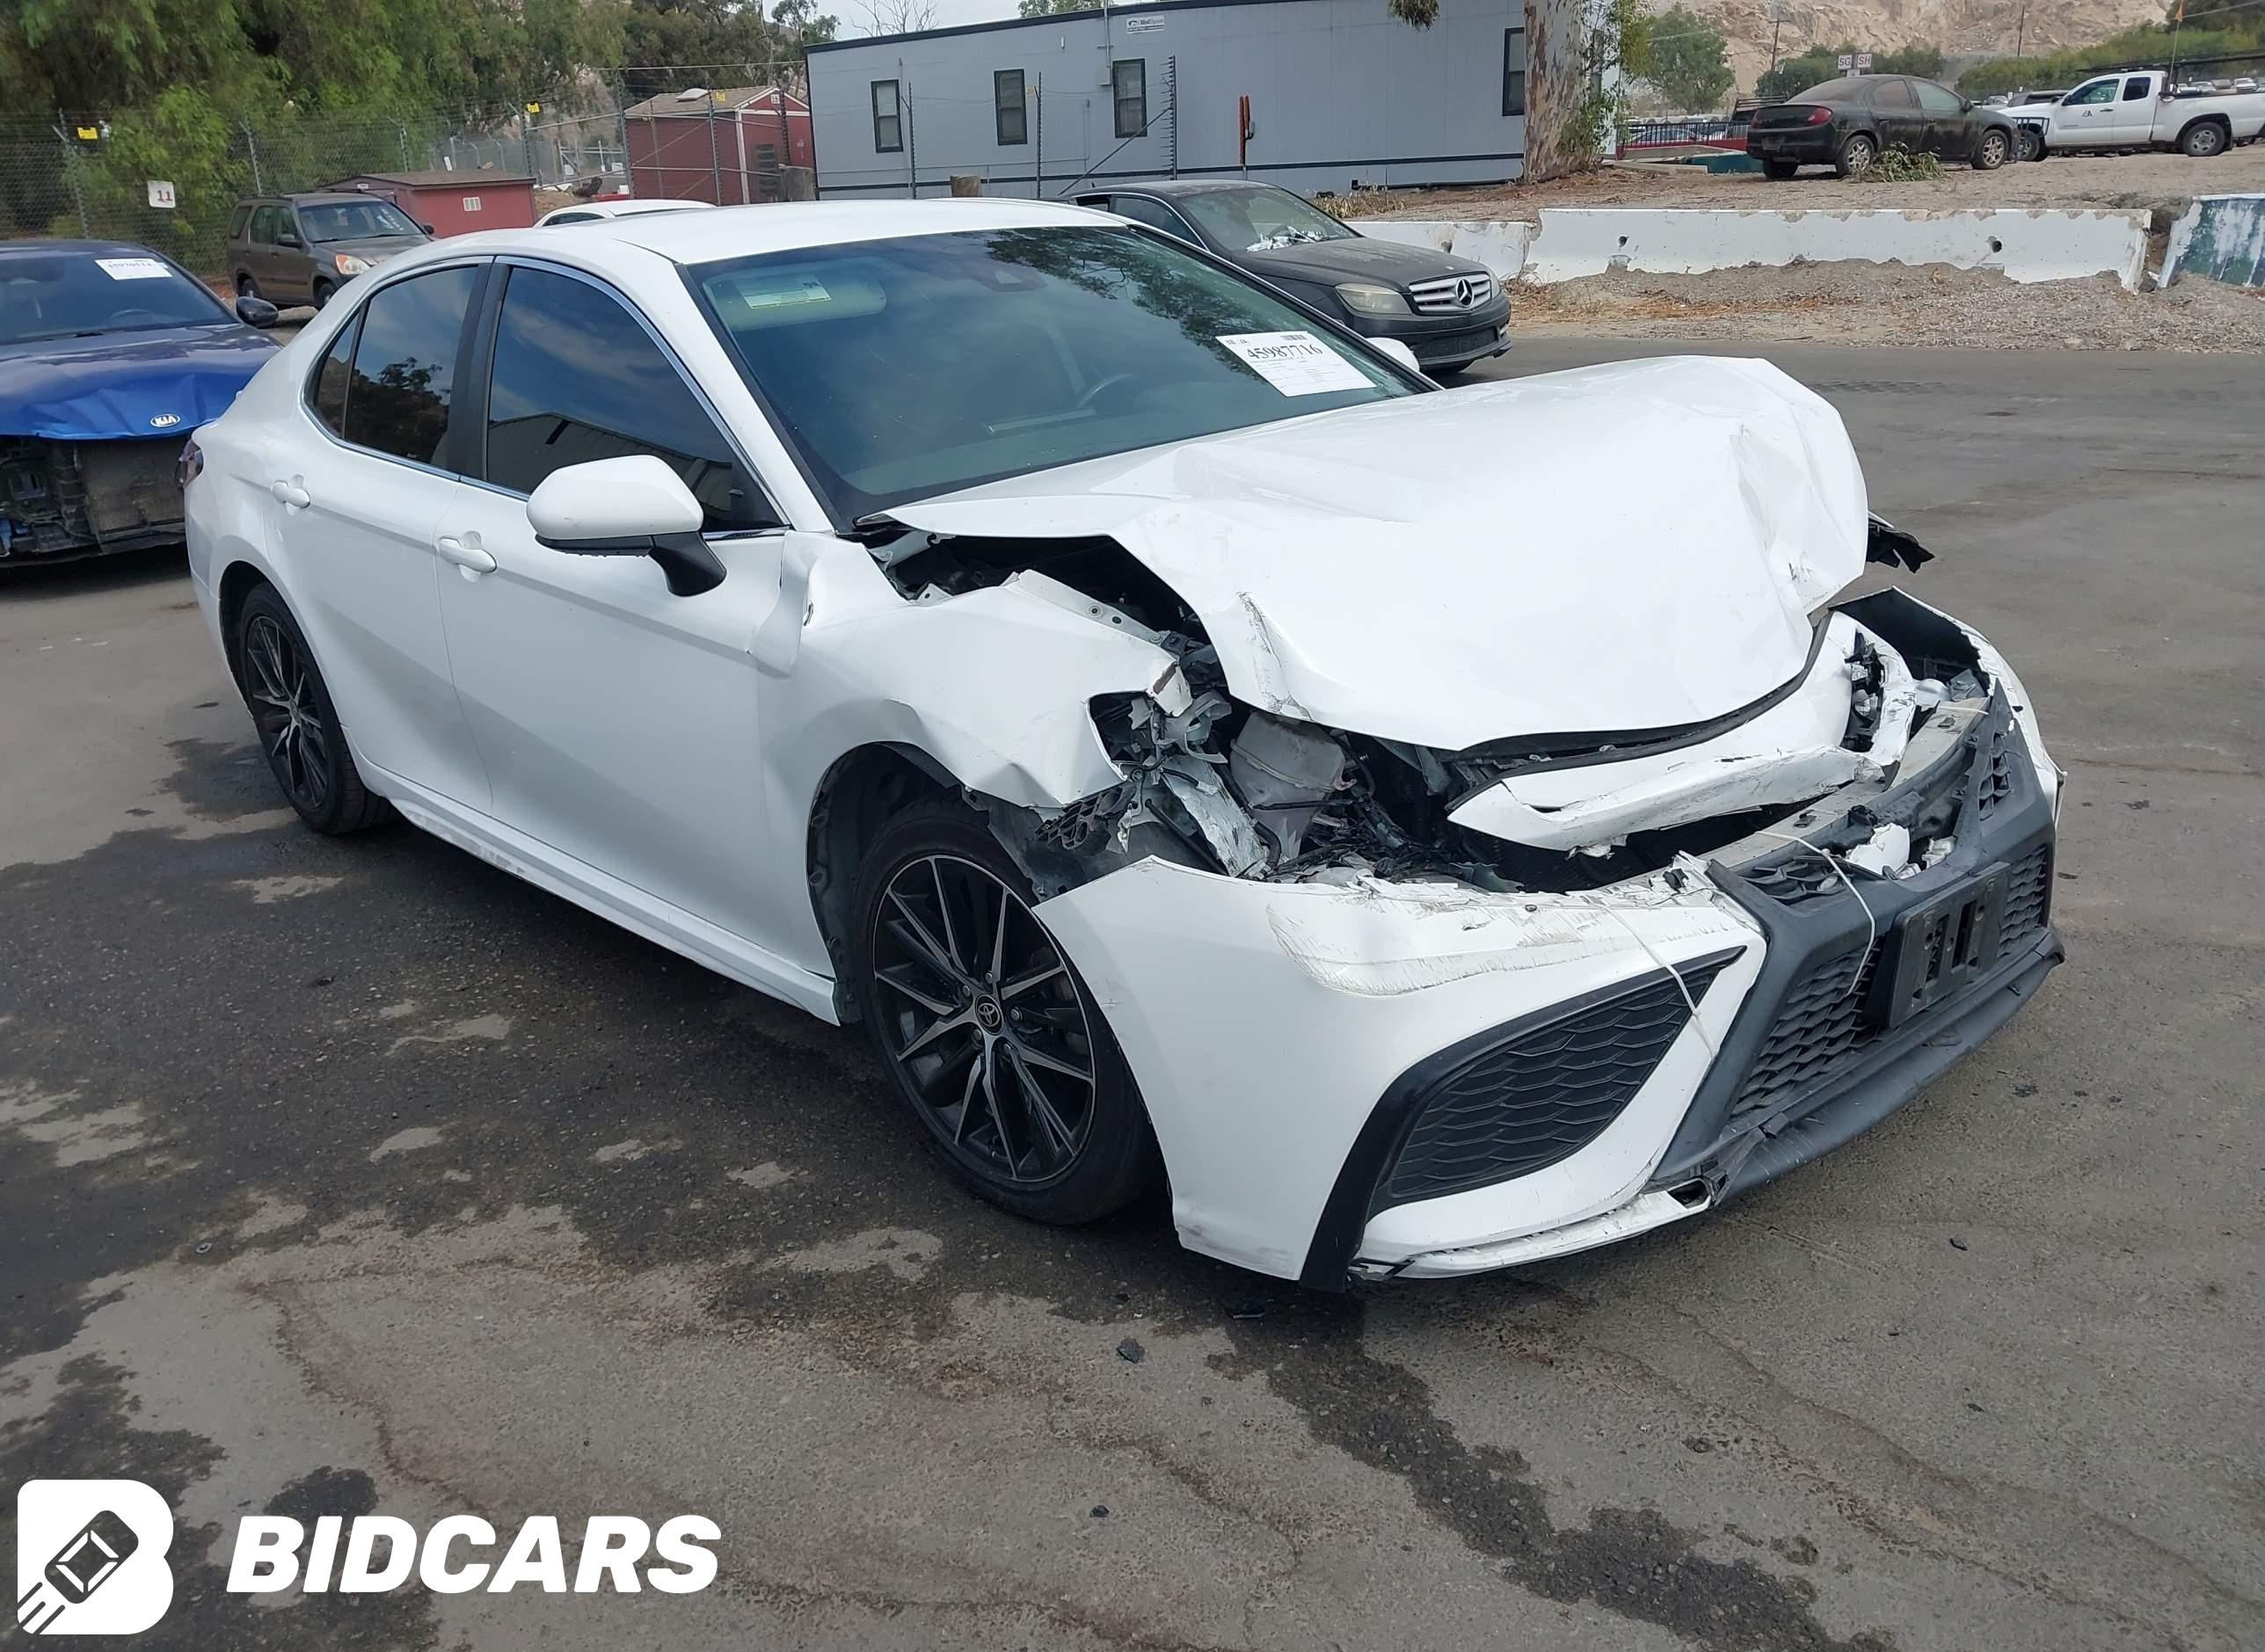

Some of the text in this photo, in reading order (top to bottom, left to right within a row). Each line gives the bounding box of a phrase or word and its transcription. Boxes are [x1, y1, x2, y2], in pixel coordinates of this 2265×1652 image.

[1839, 57, 1851, 66] SG
[1858, 55, 1871, 65] SH
[157, 189, 173, 202] 11
[1246, 344, 1323, 360] 45987716
